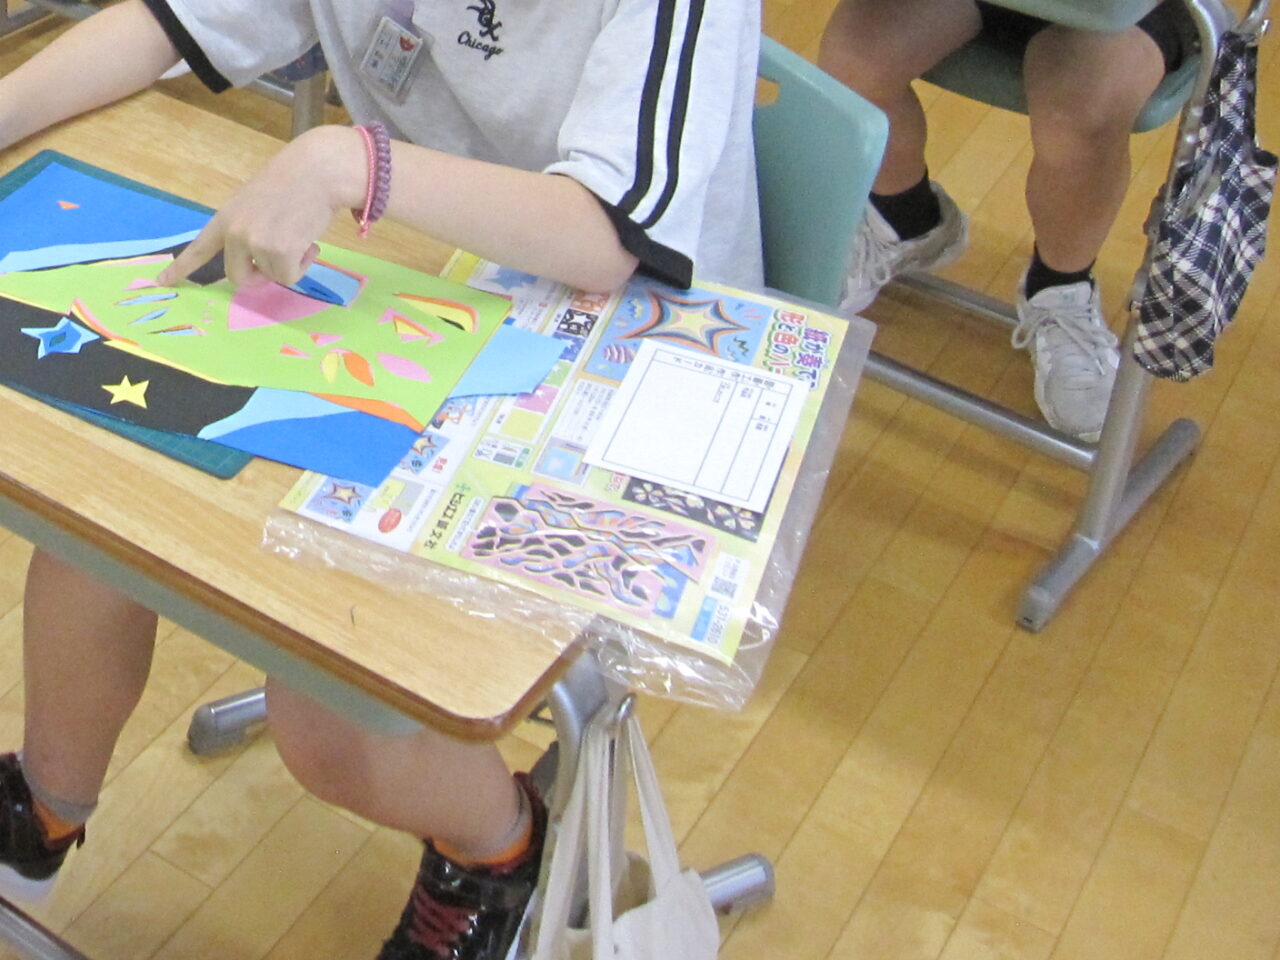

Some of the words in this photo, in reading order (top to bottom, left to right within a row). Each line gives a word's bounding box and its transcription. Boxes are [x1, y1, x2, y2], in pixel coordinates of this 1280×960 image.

[457, 30, 504, 61] Chicago
[797, 326, 830, 390] 紙が奏で
